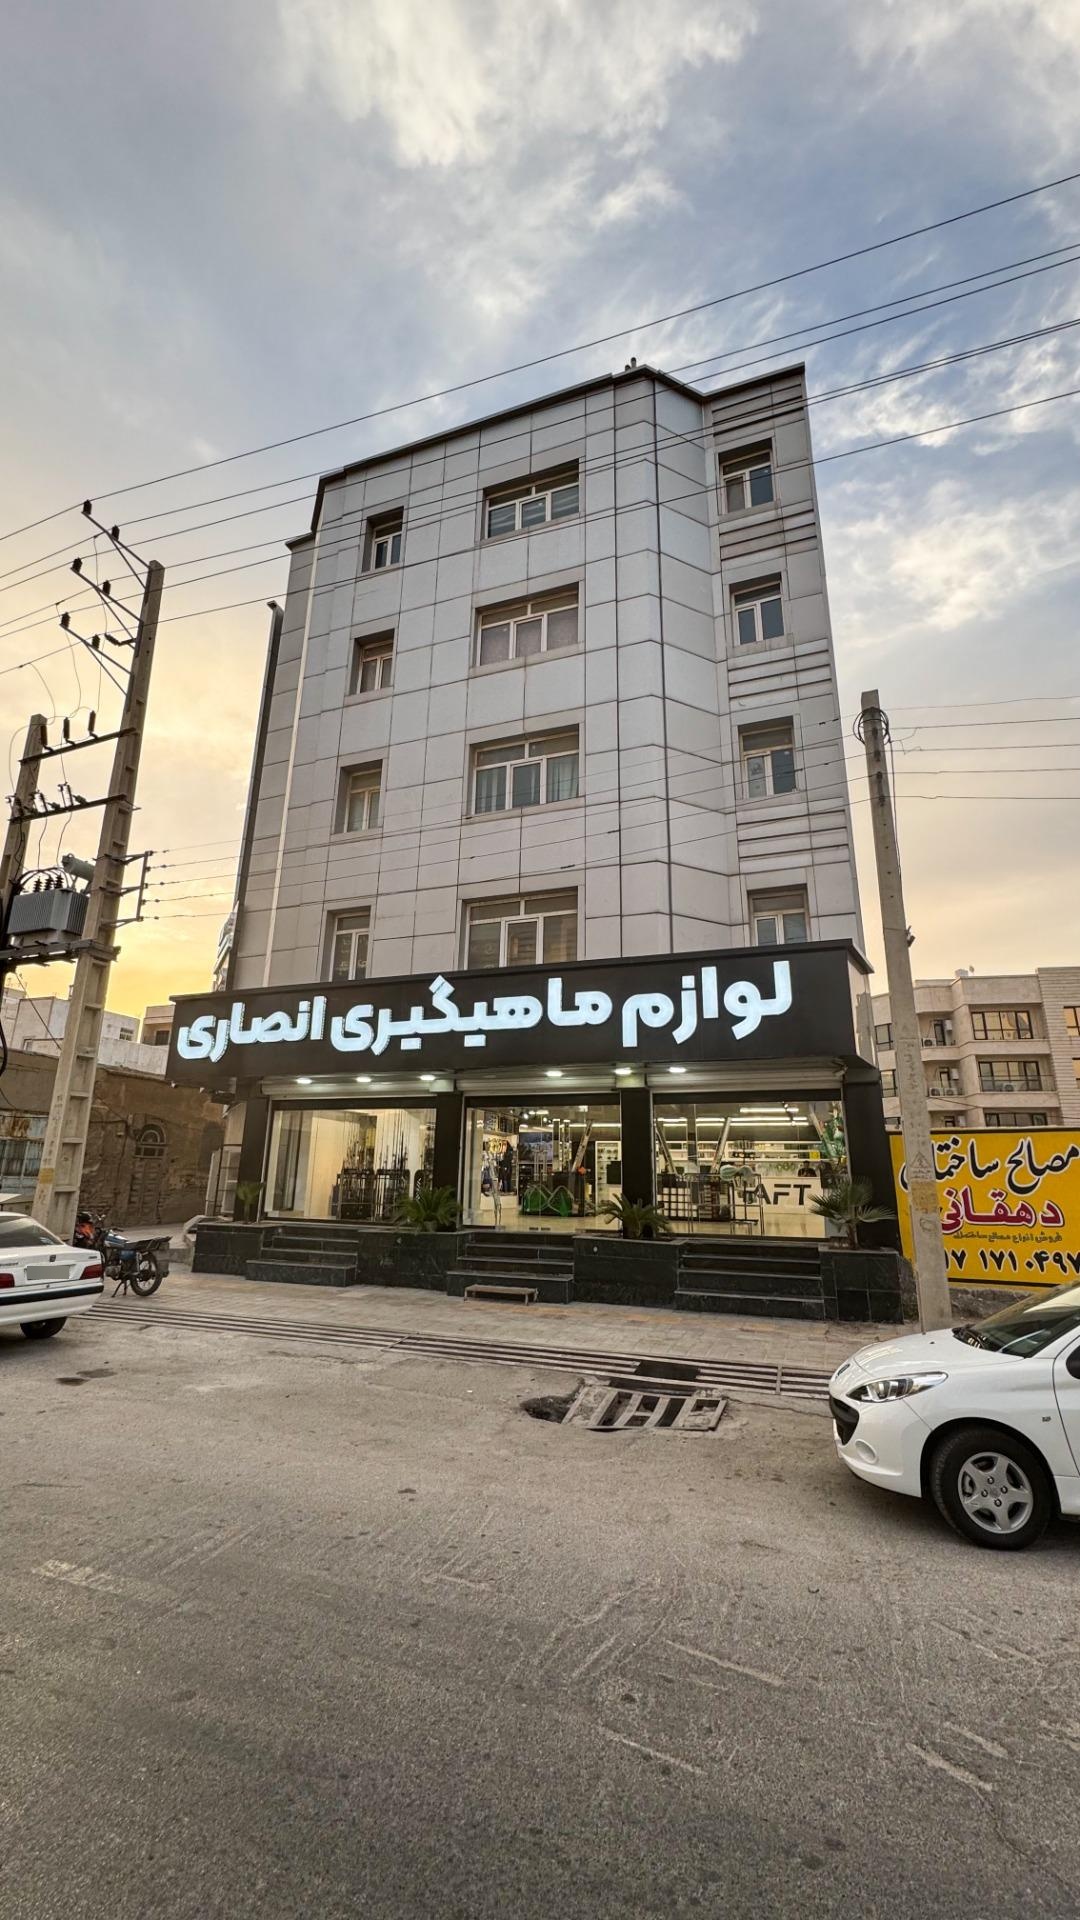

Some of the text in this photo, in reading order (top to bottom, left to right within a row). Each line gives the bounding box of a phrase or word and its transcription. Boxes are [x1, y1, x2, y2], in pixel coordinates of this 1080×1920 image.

[176, 961, 793, 1062] لوازم ماهیگیری انصاری
[901, 1137, 1080, 1195] مصالح ساختما
[750, 1183, 812, 1206] AFT
[940, 1186, 1065, 1235] دهقانی
